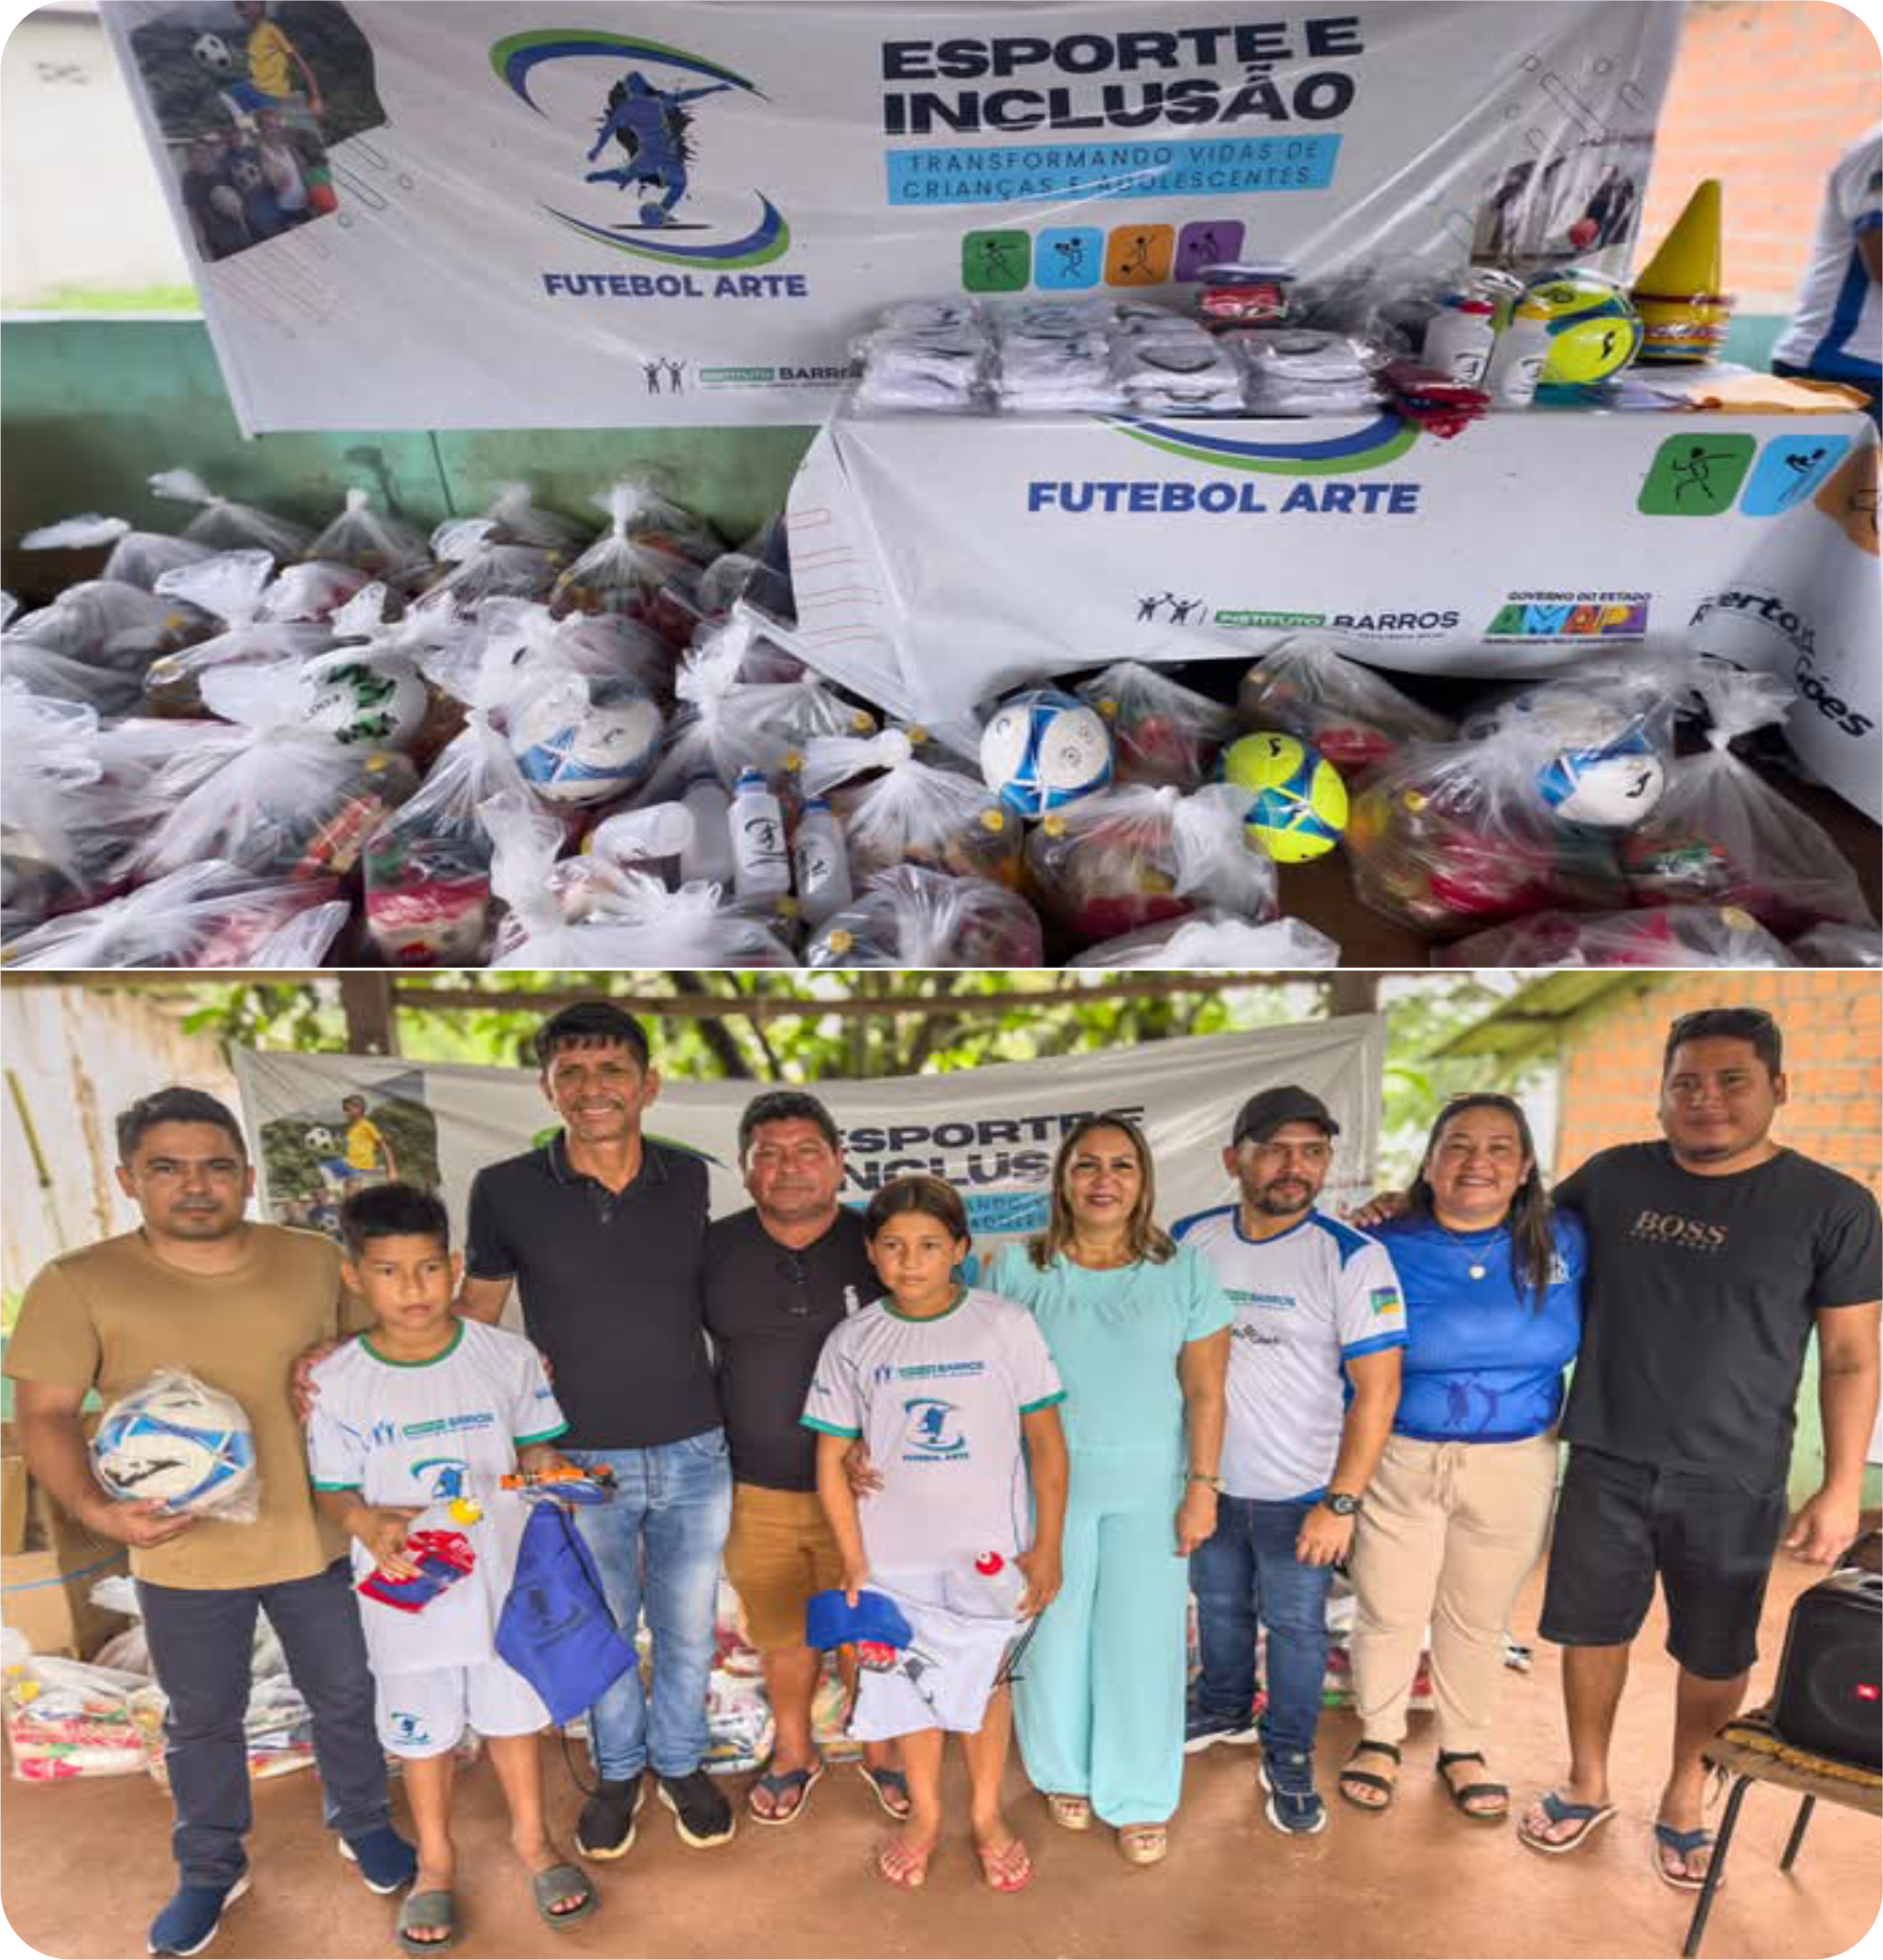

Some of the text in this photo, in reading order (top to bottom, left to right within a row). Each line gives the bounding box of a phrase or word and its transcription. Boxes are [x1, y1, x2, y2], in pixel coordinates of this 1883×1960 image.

[882, 16, 1364, 80] ESPORTE E
[883, 64, 1357, 135] INCLUSÃO
[911, 141, 1318, 174] TRANSFORMANDO VIDAS DE
[902, 177, 1054, 200] CRIANÇAS
[1067, 176, 1082, 193] E
[542, 274, 808, 298] FUTEBOL ARTE
[1026, 482, 1421, 515] FUTEBOL ARTE
[1508, 592, 1574, 601] GOVERNO
[1599, 592, 1652, 601] ESTADO
[1332, 611, 1461, 630] BARROS
[840, 1110, 1095, 1154] SPORT
[1637, 1209, 1726, 1244] BOSS
